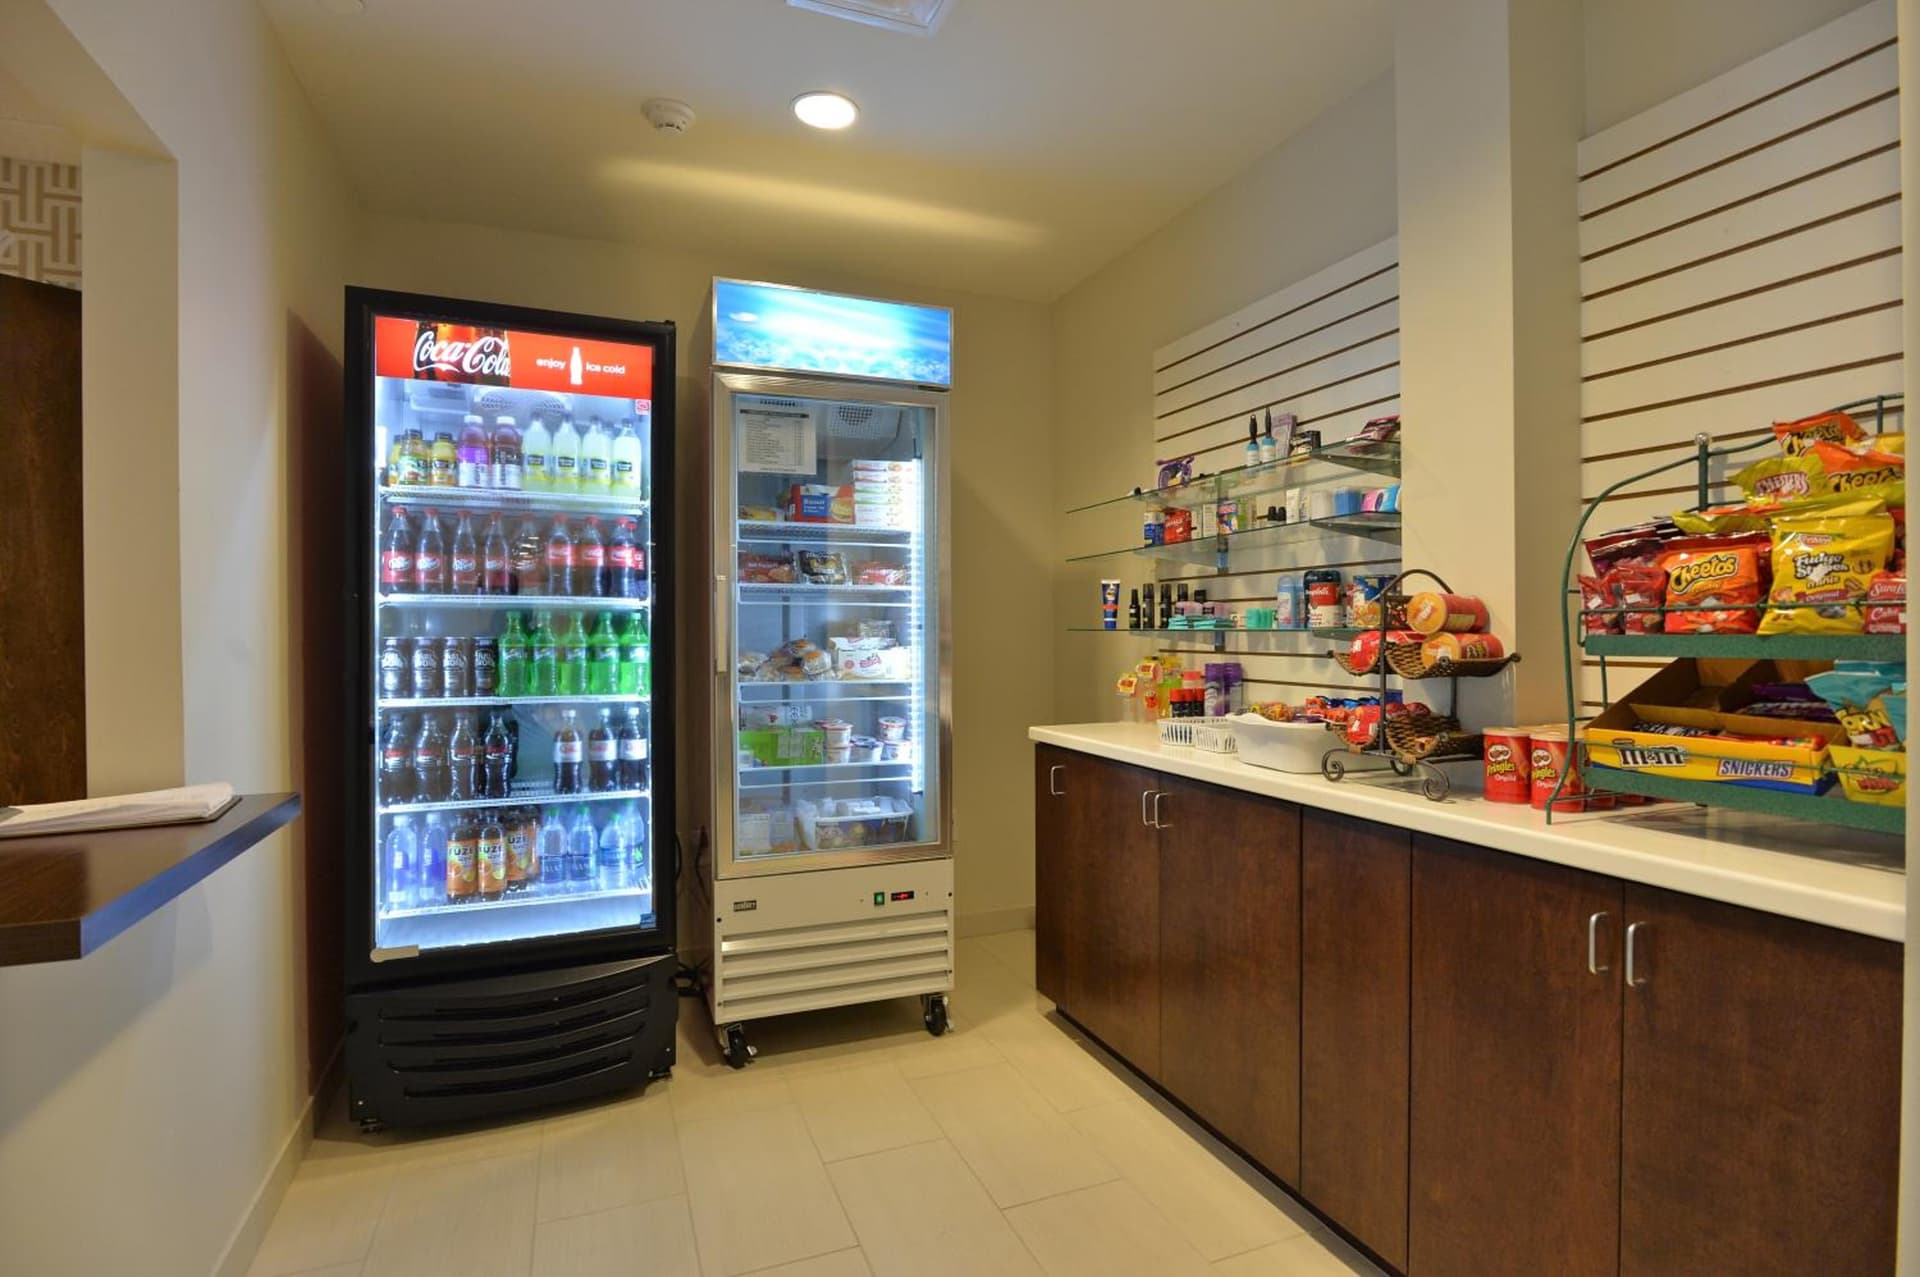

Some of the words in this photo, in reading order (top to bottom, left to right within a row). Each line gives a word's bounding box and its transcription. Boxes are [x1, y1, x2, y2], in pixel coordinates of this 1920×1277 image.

[413, 330, 511, 377] Coca-Cola
[536, 358, 566, 370] enjoy
[586, 361, 602, 373] ice
[602, 364, 626, 375] cold
[1794, 552, 1843, 567] Fudge
[1669, 555, 1738, 595] Cheetos
[1488, 761, 1516, 777] Pringles
[1720, 760, 1792, 777] SNICKERS
